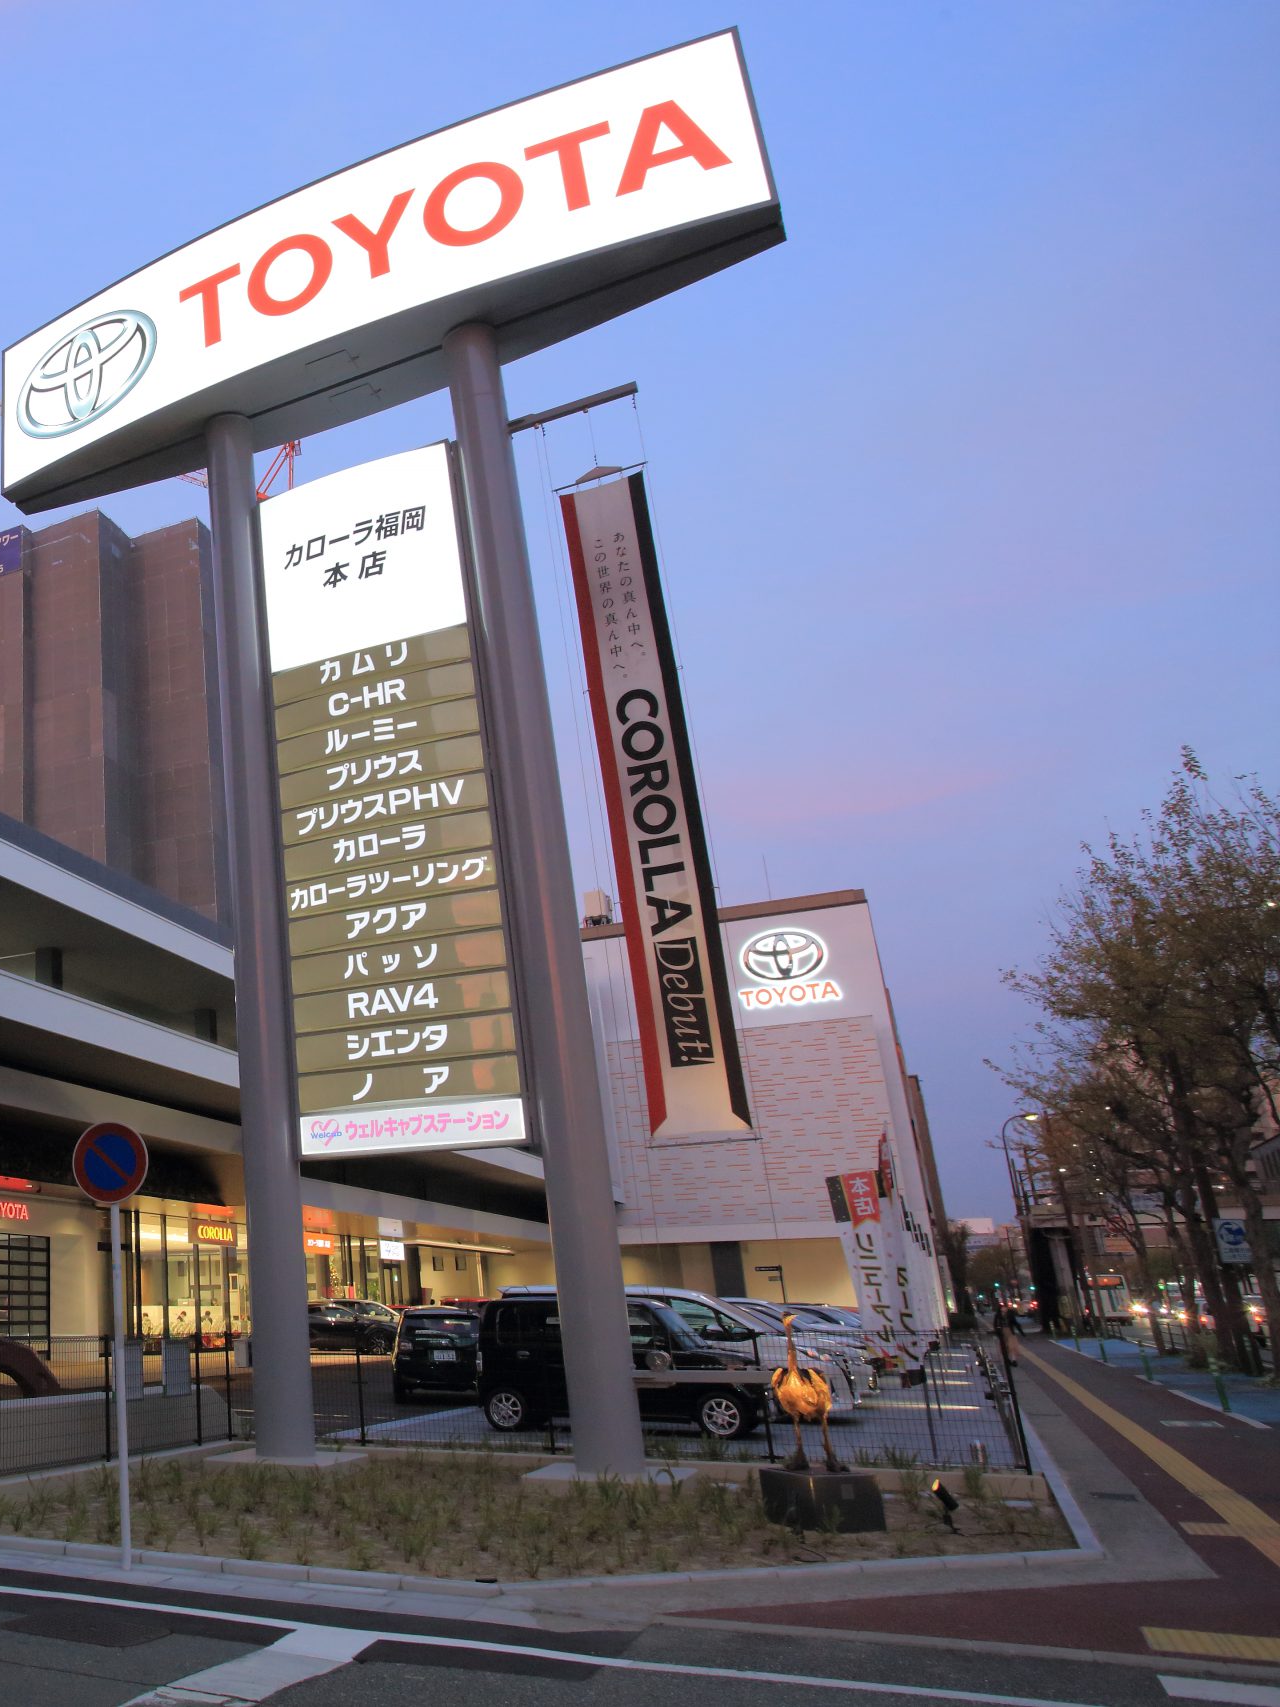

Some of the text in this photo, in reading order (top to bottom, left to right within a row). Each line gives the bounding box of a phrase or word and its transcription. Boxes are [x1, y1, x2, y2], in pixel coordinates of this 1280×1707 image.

[179, 99, 732, 348] TOYOTA
[284, 505, 426, 570] カローラ福岡
[323, 550, 387, 588] 本店
[320, 641, 408, 684] カムリ
[328, 678, 406, 717] C-HR
[325, 717, 417, 754] ルーミー
[327, 750, 422, 791] プリウス
[297, 779, 465, 835] プリウスPHV
[616, 688, 693, 937] COROLLA
[333, 824, 426, 864] カローラ
[290, 856, 488, 911] カローラツーリング
[346, 902, 427, 939] アクア
[344, 943, 438, 979] パッソ
[347, 982, 439, 1019] RAV4
[655, 940, 715, 1063] Debut!
[740, 981, 841, 1009] TOYOTA
[346, 1024, 448, 1060] シエンタ
[344, 1110, 509, 1141] ウェルキャブステーション
[198, 1225, 233, 1242] COROLLA
